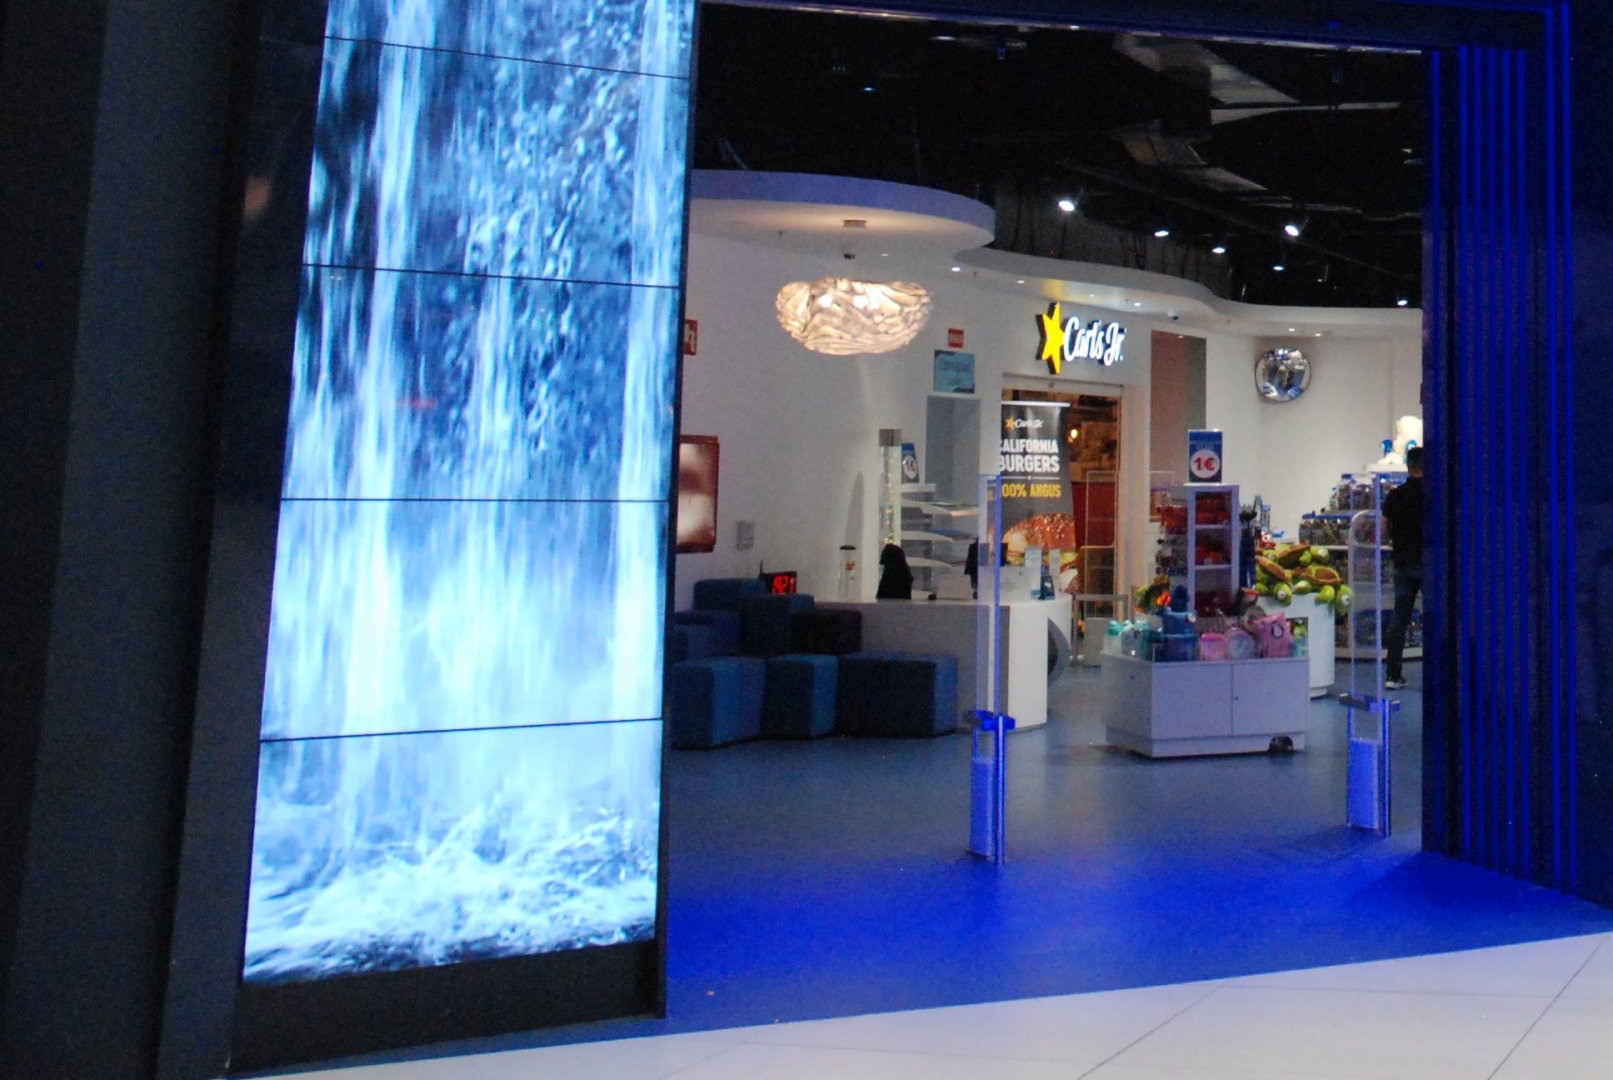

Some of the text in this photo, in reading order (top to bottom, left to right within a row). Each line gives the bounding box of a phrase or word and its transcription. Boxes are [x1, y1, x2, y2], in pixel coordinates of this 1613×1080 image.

[1063, 316, 1105, 362] Carl's
[1194, 456, 1216, 472] 1€
[1001, 483, 1061, 498] 00% ANGUS
